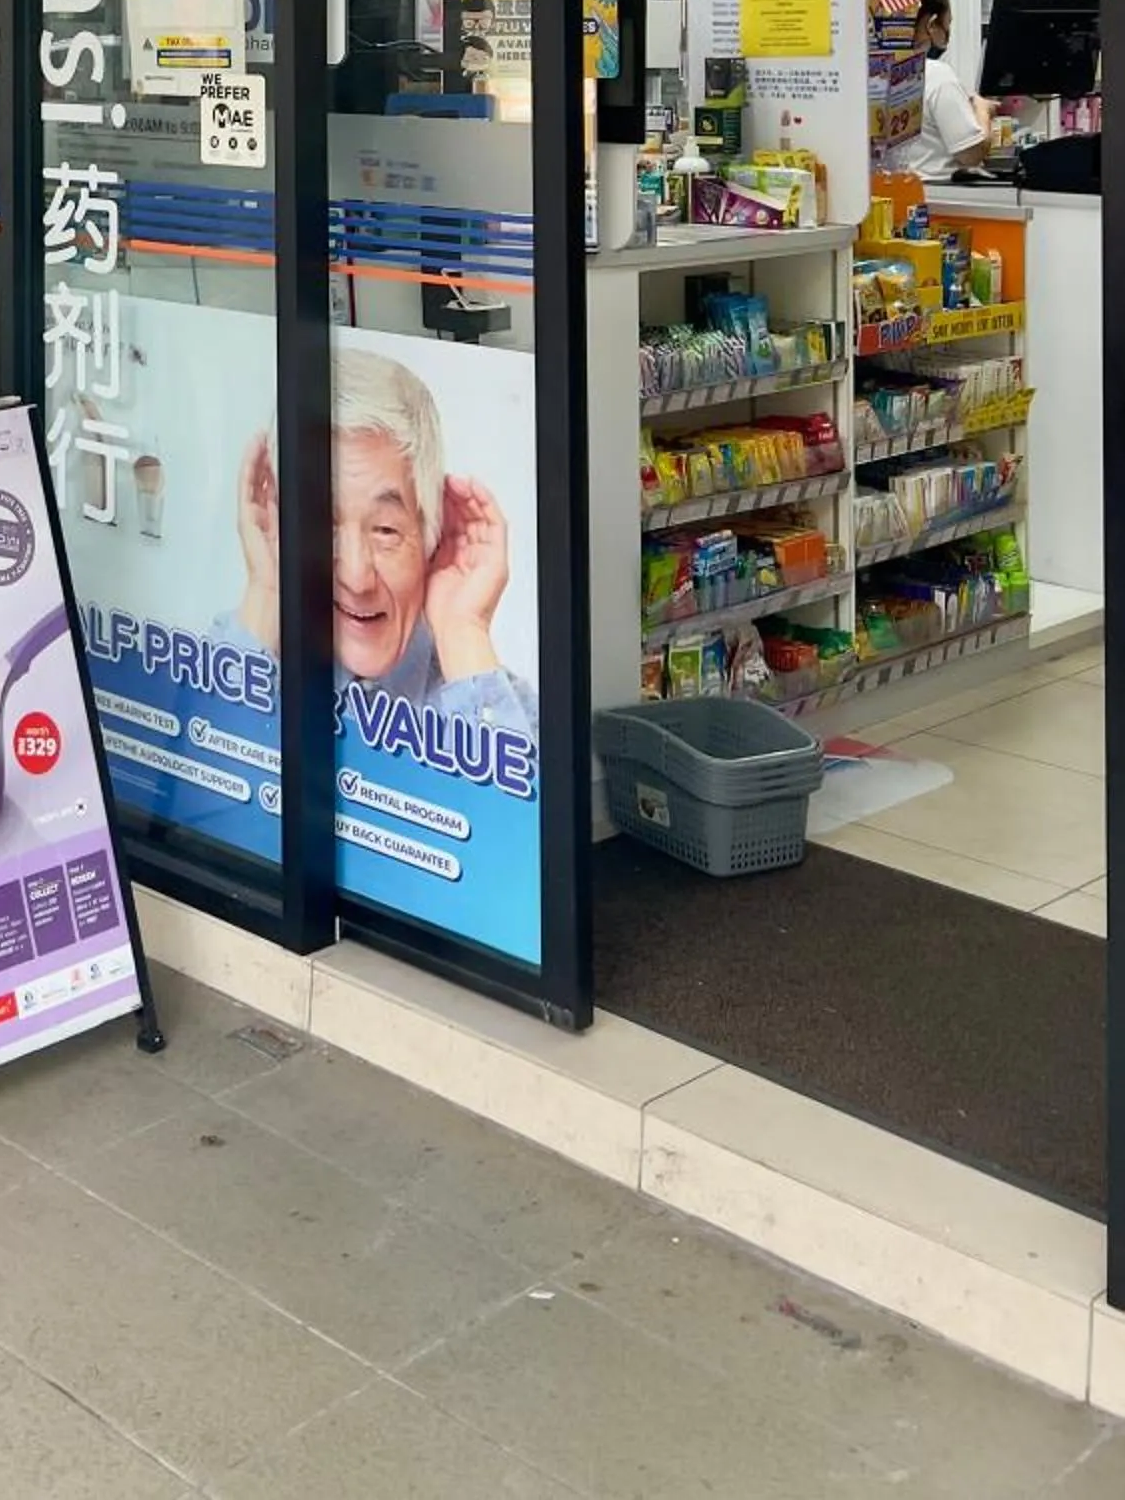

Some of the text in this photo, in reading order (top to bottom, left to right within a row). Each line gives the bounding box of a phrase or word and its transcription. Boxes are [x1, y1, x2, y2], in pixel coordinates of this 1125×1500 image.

[200, 85, 250, 101] PREFER
[201, 73, 222, 85] WE
[212, 103, 254, 129] MAE
[42, 161, 130, 524] 药剂行
[79, 604, 135, 662] LF
[143, 618, 273, 713] PRICE
[114, 702, 152, 722] HEARING
[154, 714, 175, 730] TEST
[208, 732, 239, 752] AFTER
[240, 745, 265, 762] CARE
[348, 681, 532, 798] VALUE
[139, 745, 199, 777] AUDIOLOGIST
[200, 770, 245, 794] SUPPORT
[360, 786, 463, 832] RENTAL PROGRAM
[352, 825, 384, 845] BACK
[384, 837, 452, 873] GUARANTEE
